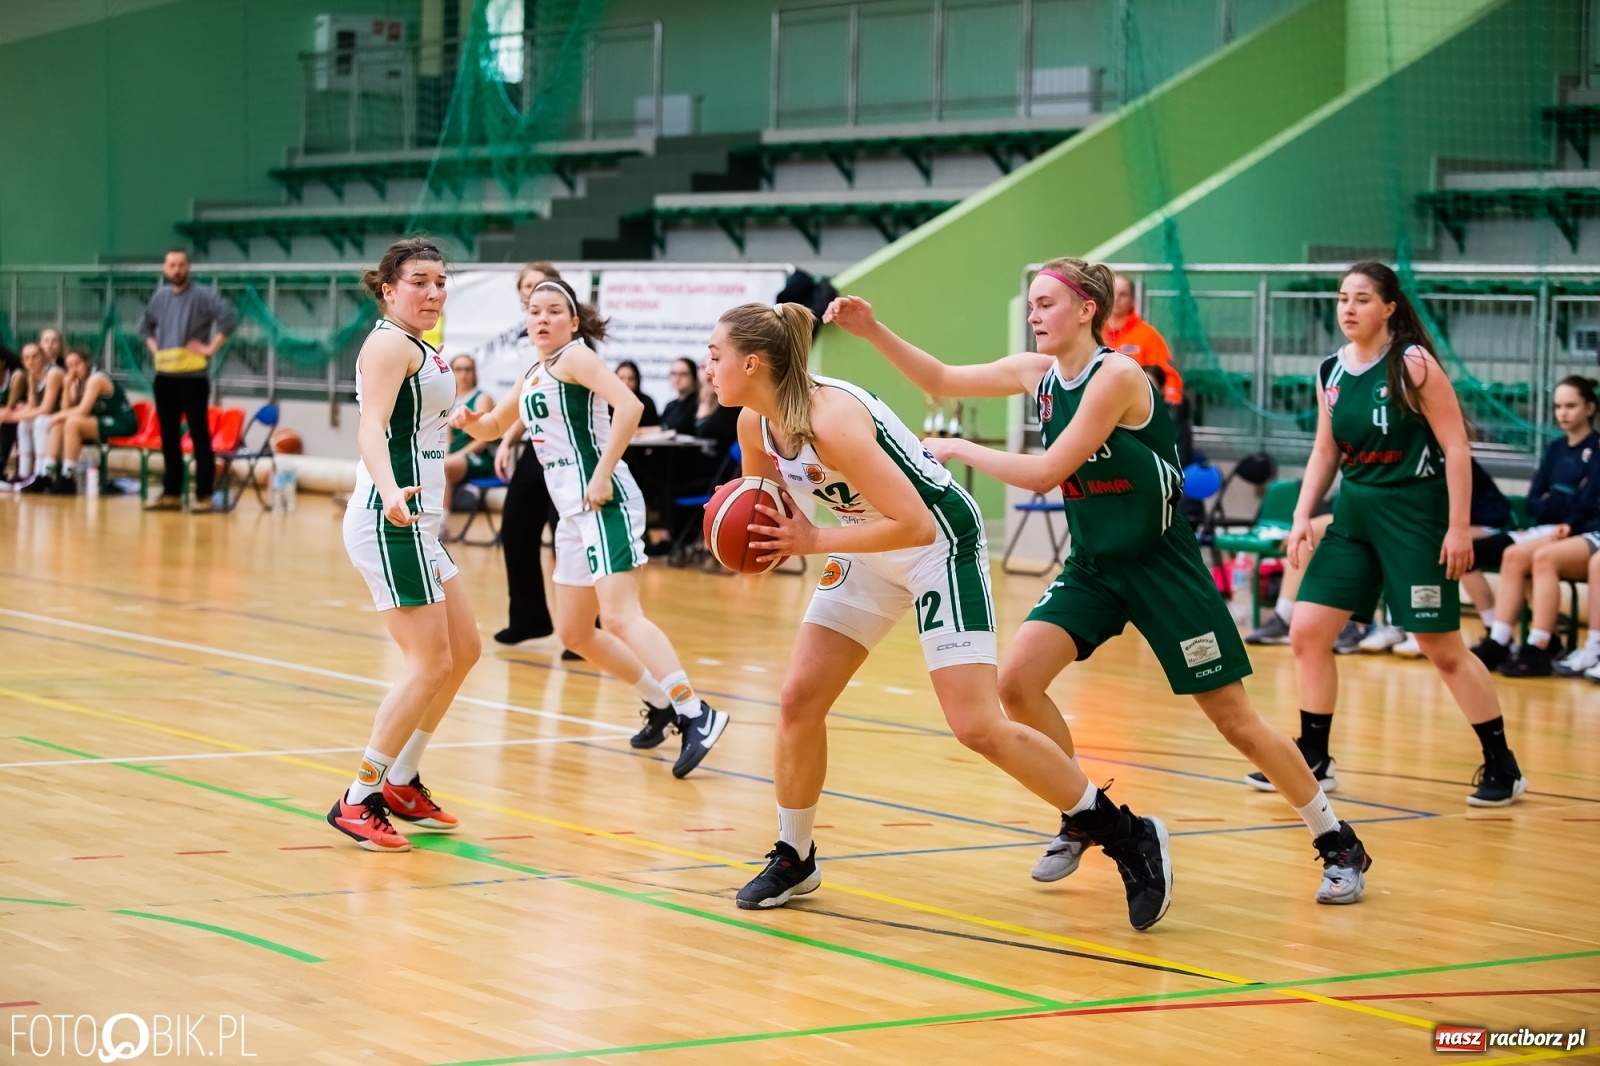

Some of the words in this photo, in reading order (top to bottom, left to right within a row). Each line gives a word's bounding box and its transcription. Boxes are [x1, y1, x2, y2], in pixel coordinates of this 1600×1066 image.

[525, 392, 549, 421] 16
[1373, 405, 1389, 435] 4
[812, 482, 860, 504] 12
[915, 590, 944, 634] 12
[936, 641, 972, 652] COLO
[1195, 664, 1222, 678] COLO
